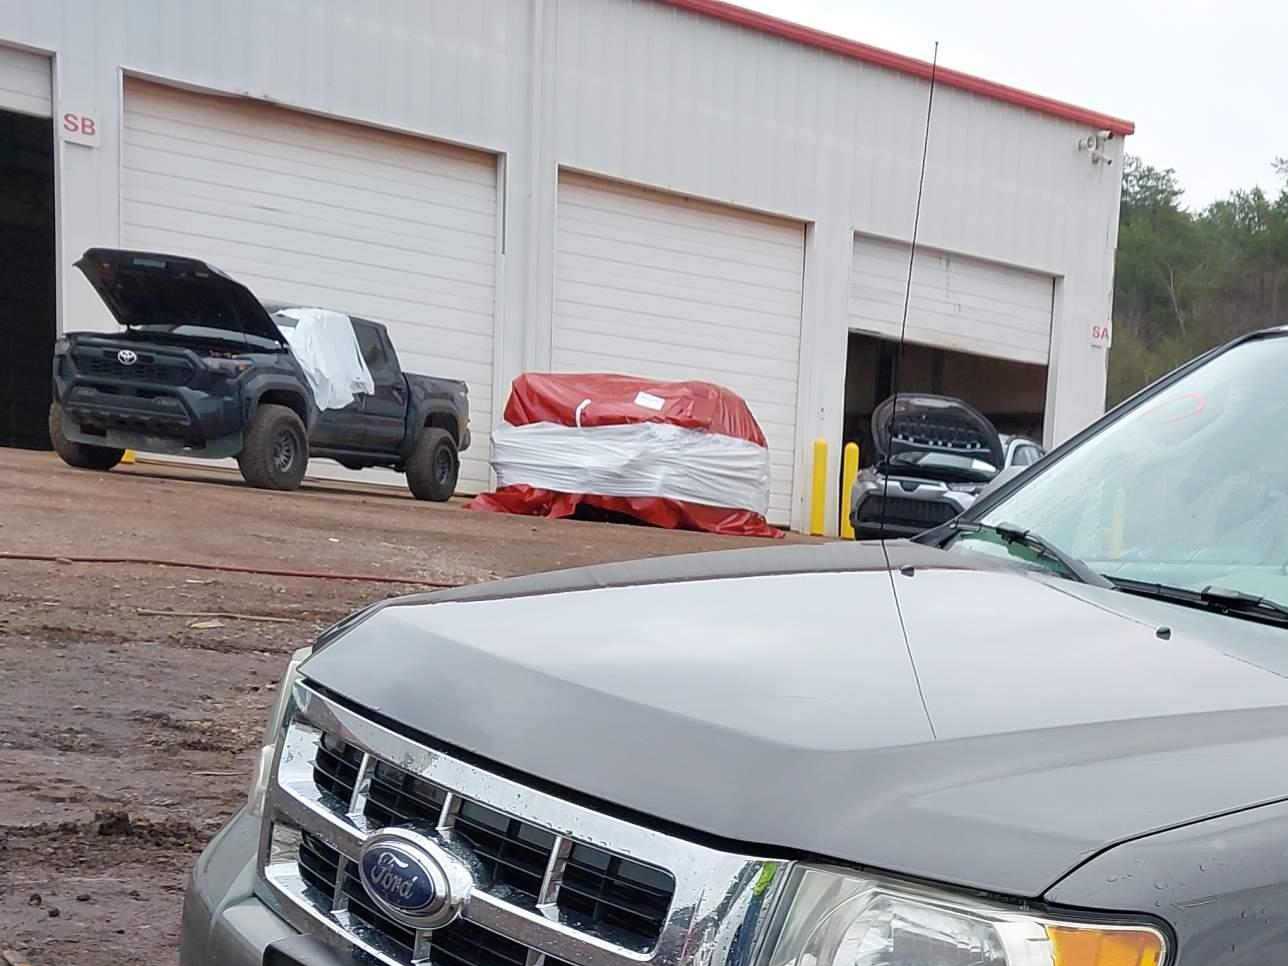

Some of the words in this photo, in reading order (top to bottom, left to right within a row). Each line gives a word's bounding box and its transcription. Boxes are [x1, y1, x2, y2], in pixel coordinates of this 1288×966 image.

[64, 113, 96, 136] SB
[1092, 326, 1109, 340] SA
[371, 852, 418, 899] Ford
